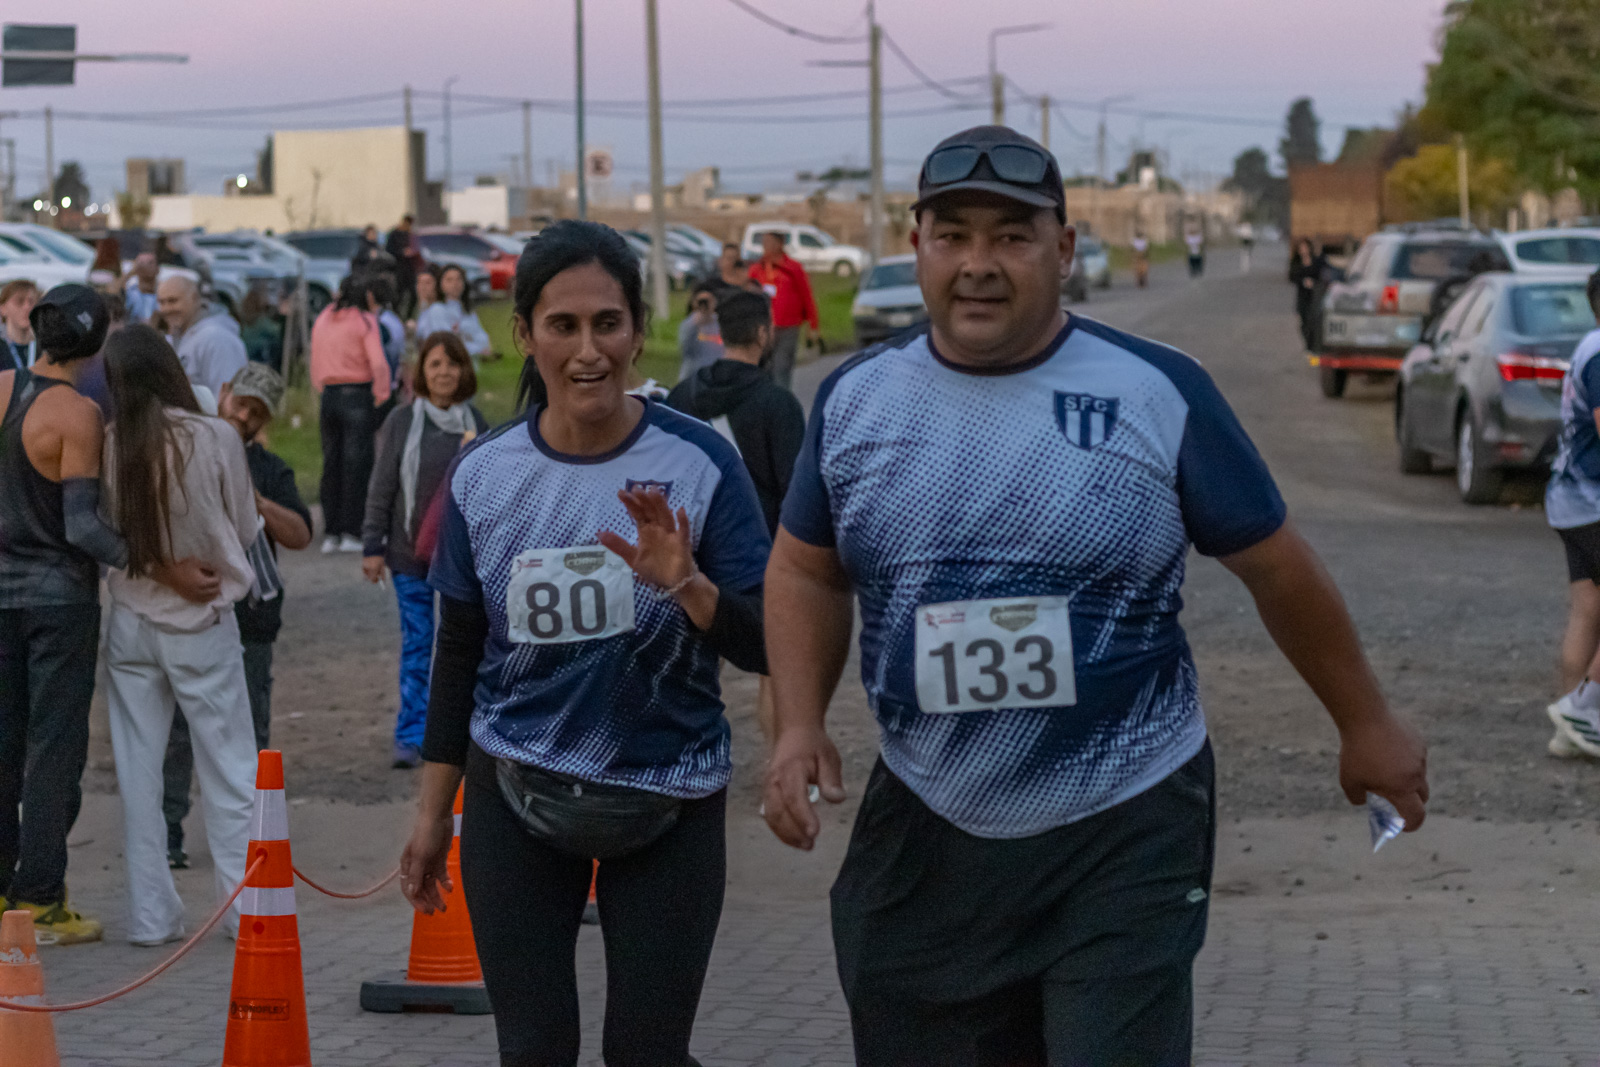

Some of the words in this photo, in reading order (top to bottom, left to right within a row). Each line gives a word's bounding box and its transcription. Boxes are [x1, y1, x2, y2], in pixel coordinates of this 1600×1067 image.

[1064, 395, 1108, 412] SFC
[526, 579, 607, 639] 80
[929, 635, 1057, 705] 133
